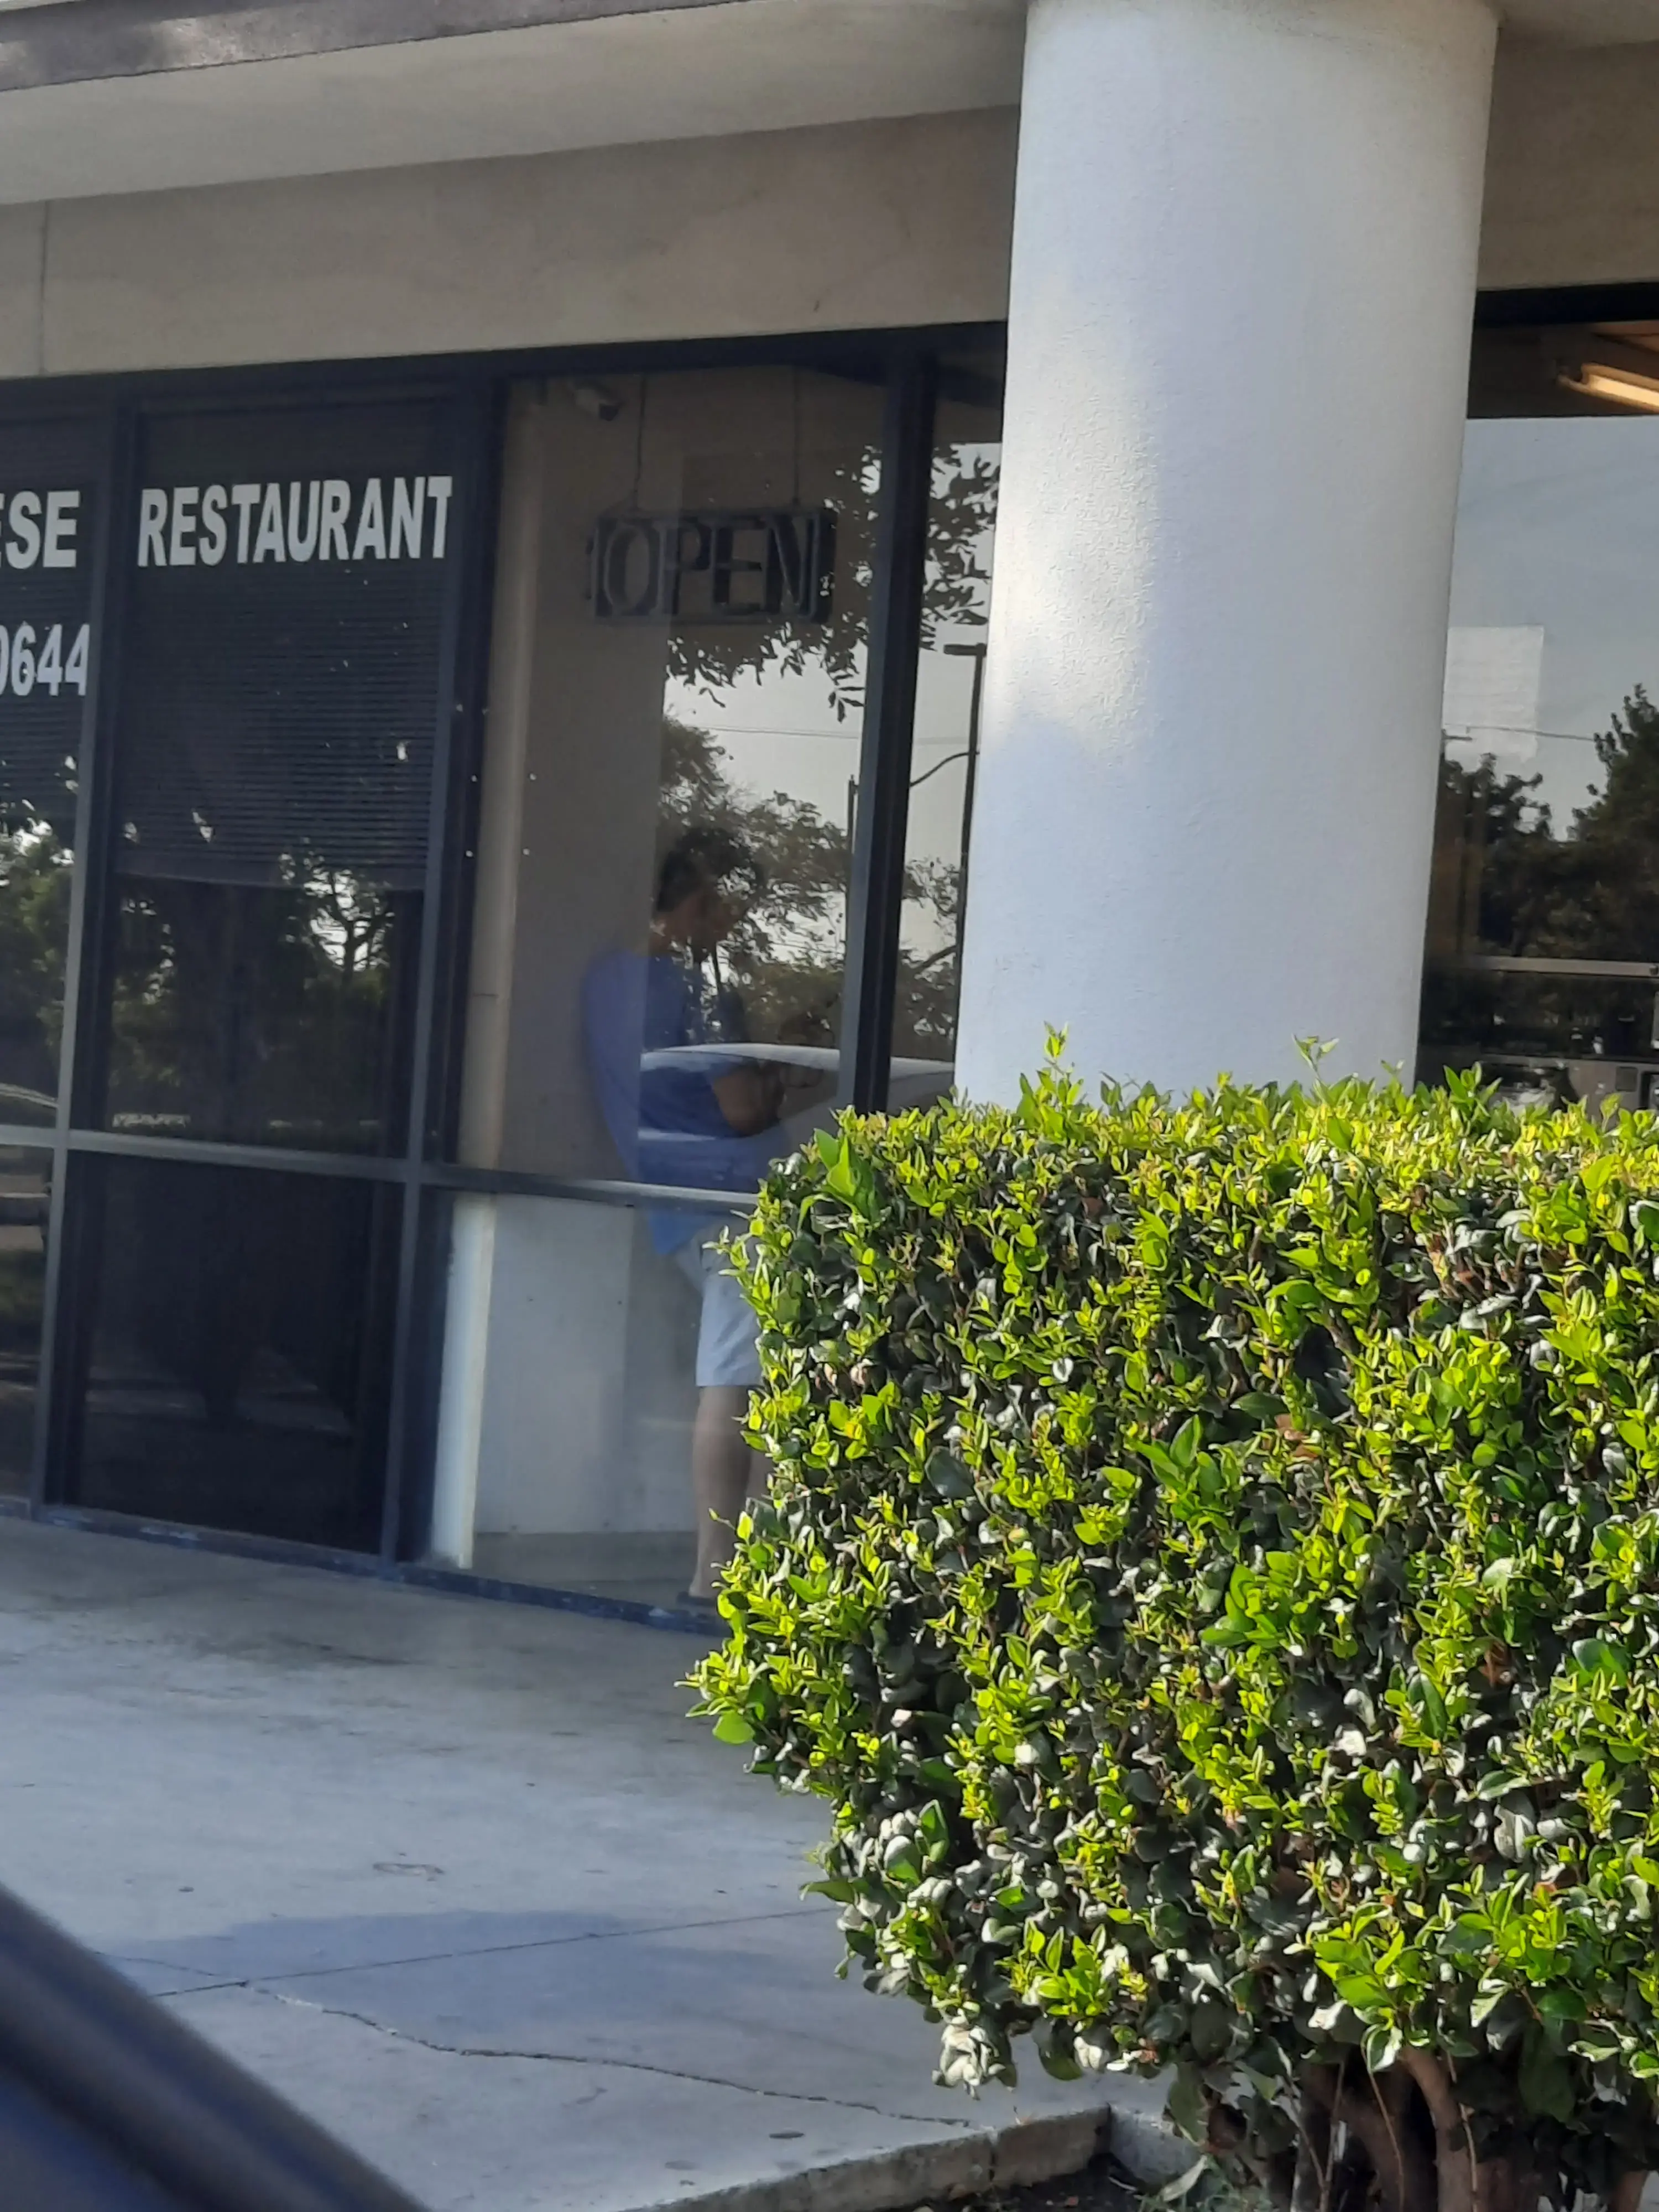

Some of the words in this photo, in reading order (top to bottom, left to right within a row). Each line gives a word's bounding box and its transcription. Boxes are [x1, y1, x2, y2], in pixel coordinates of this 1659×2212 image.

[0, 491, 80, 569] SE
[138, 476, 452, 566] RESTAURANT
[603, 515, 821, 617] OPEN
